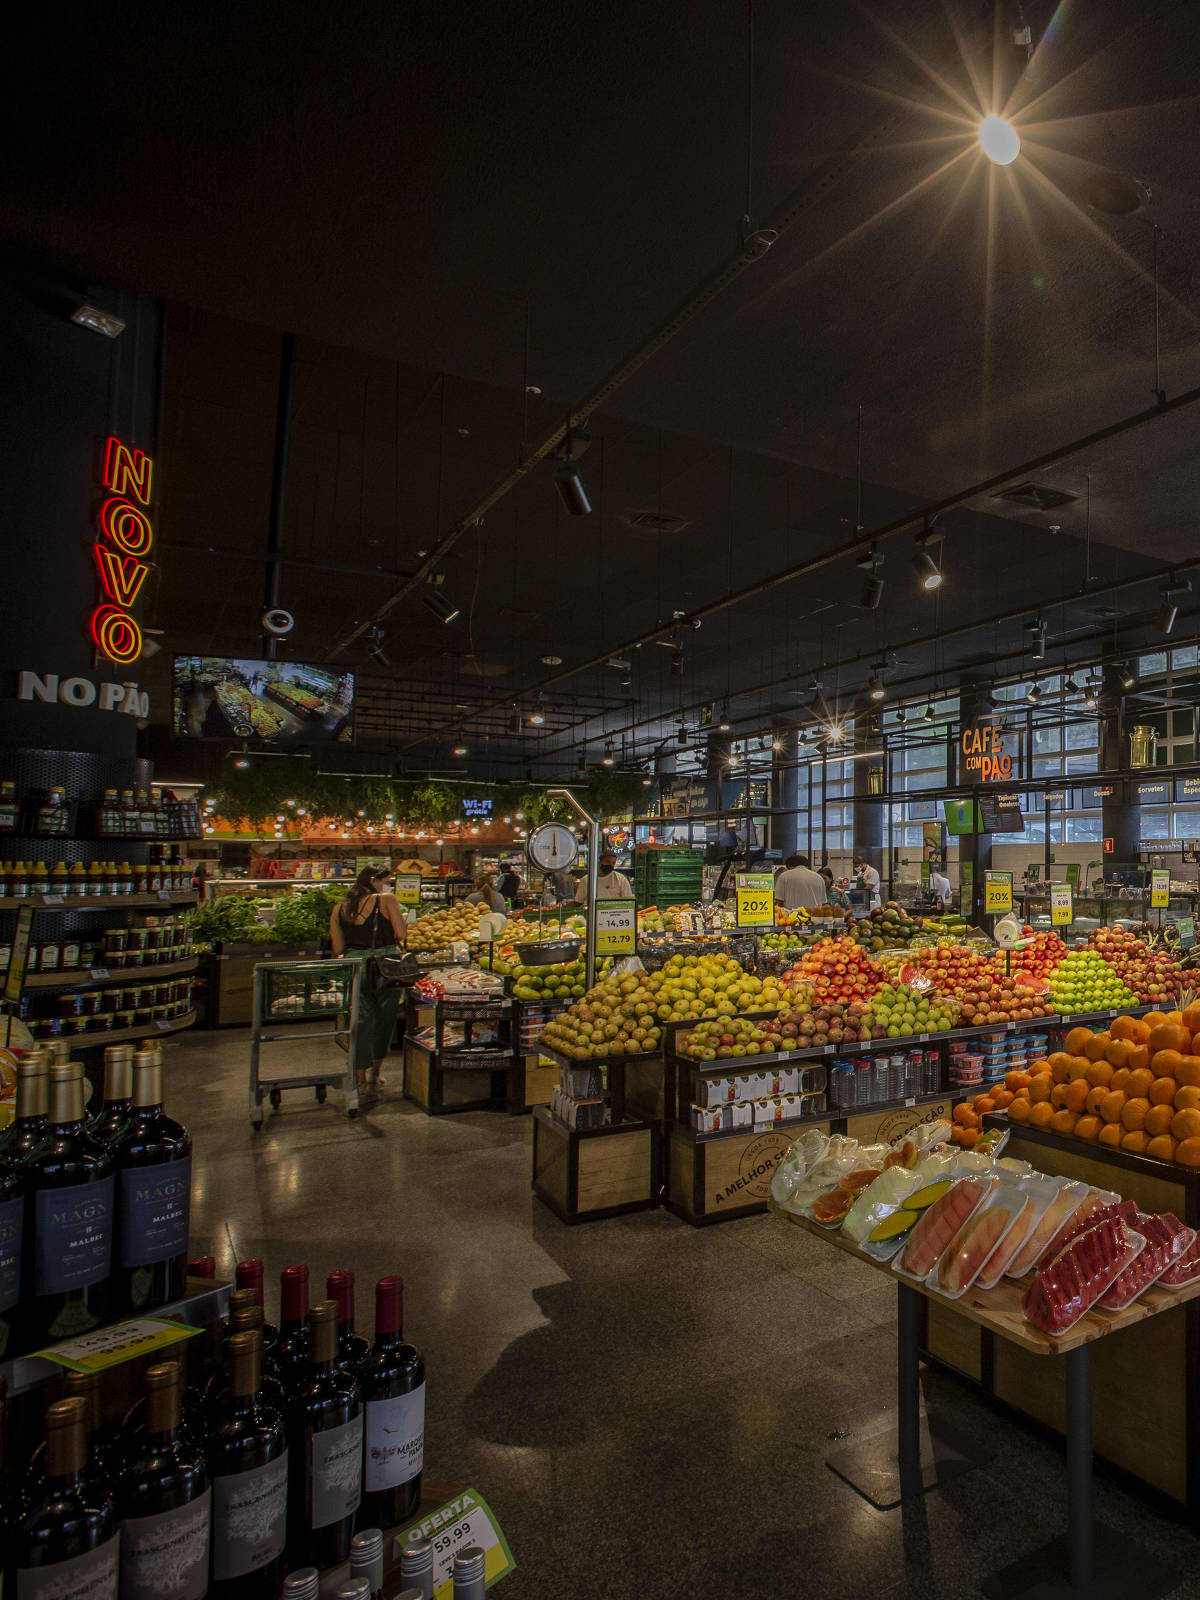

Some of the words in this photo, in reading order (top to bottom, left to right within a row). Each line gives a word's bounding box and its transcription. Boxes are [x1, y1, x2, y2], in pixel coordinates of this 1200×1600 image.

[91, 437, 153, 664] NOVO
[17, 670, 97, 707] NO
[99, 681, 149, 719] PÃO
[962, 717, 1004, 756] CAFÉ
[966, 756, 982, 770] COM
[462, 799, 493, 809] Wi-Fi
[990, 893, 1009, 901] 20%
[742, 900, 769, 912] 20%
[606, 919, 631, 929] 14,99
[607, 935, 631, 944] 12,79
[715, 1193, 725, 1204] A
[725, 1159, 774, 1197] MELHOR
[70, 1233, 105, 1249] MALBEC
[408, 1495, 476, 1543] OFERTA
[433, 1522, 471, 1553] 59,99
